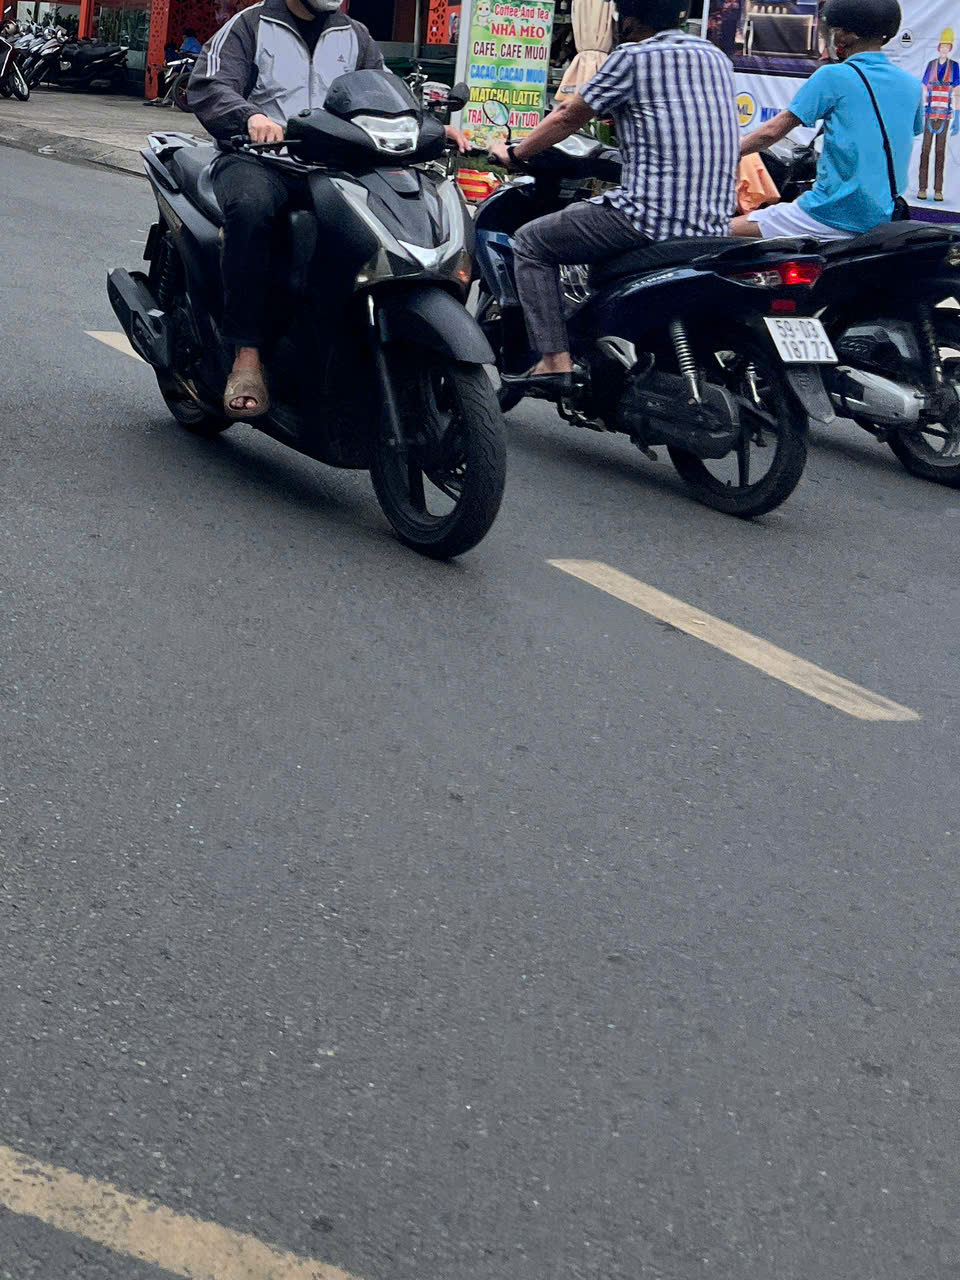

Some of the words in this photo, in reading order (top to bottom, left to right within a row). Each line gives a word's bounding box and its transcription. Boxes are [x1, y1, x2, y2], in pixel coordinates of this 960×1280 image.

[495, 4, 518, 17] Coffee
[521, 6, 535, 18] And
[537, 7, 549, 20] Tea
[501, 44, 522, 58] CAFE
[470, 87, 510, 104] MATCHA
[512, 90, 541, 106] LATTE
[508, 108, 520, 126] ÂY
